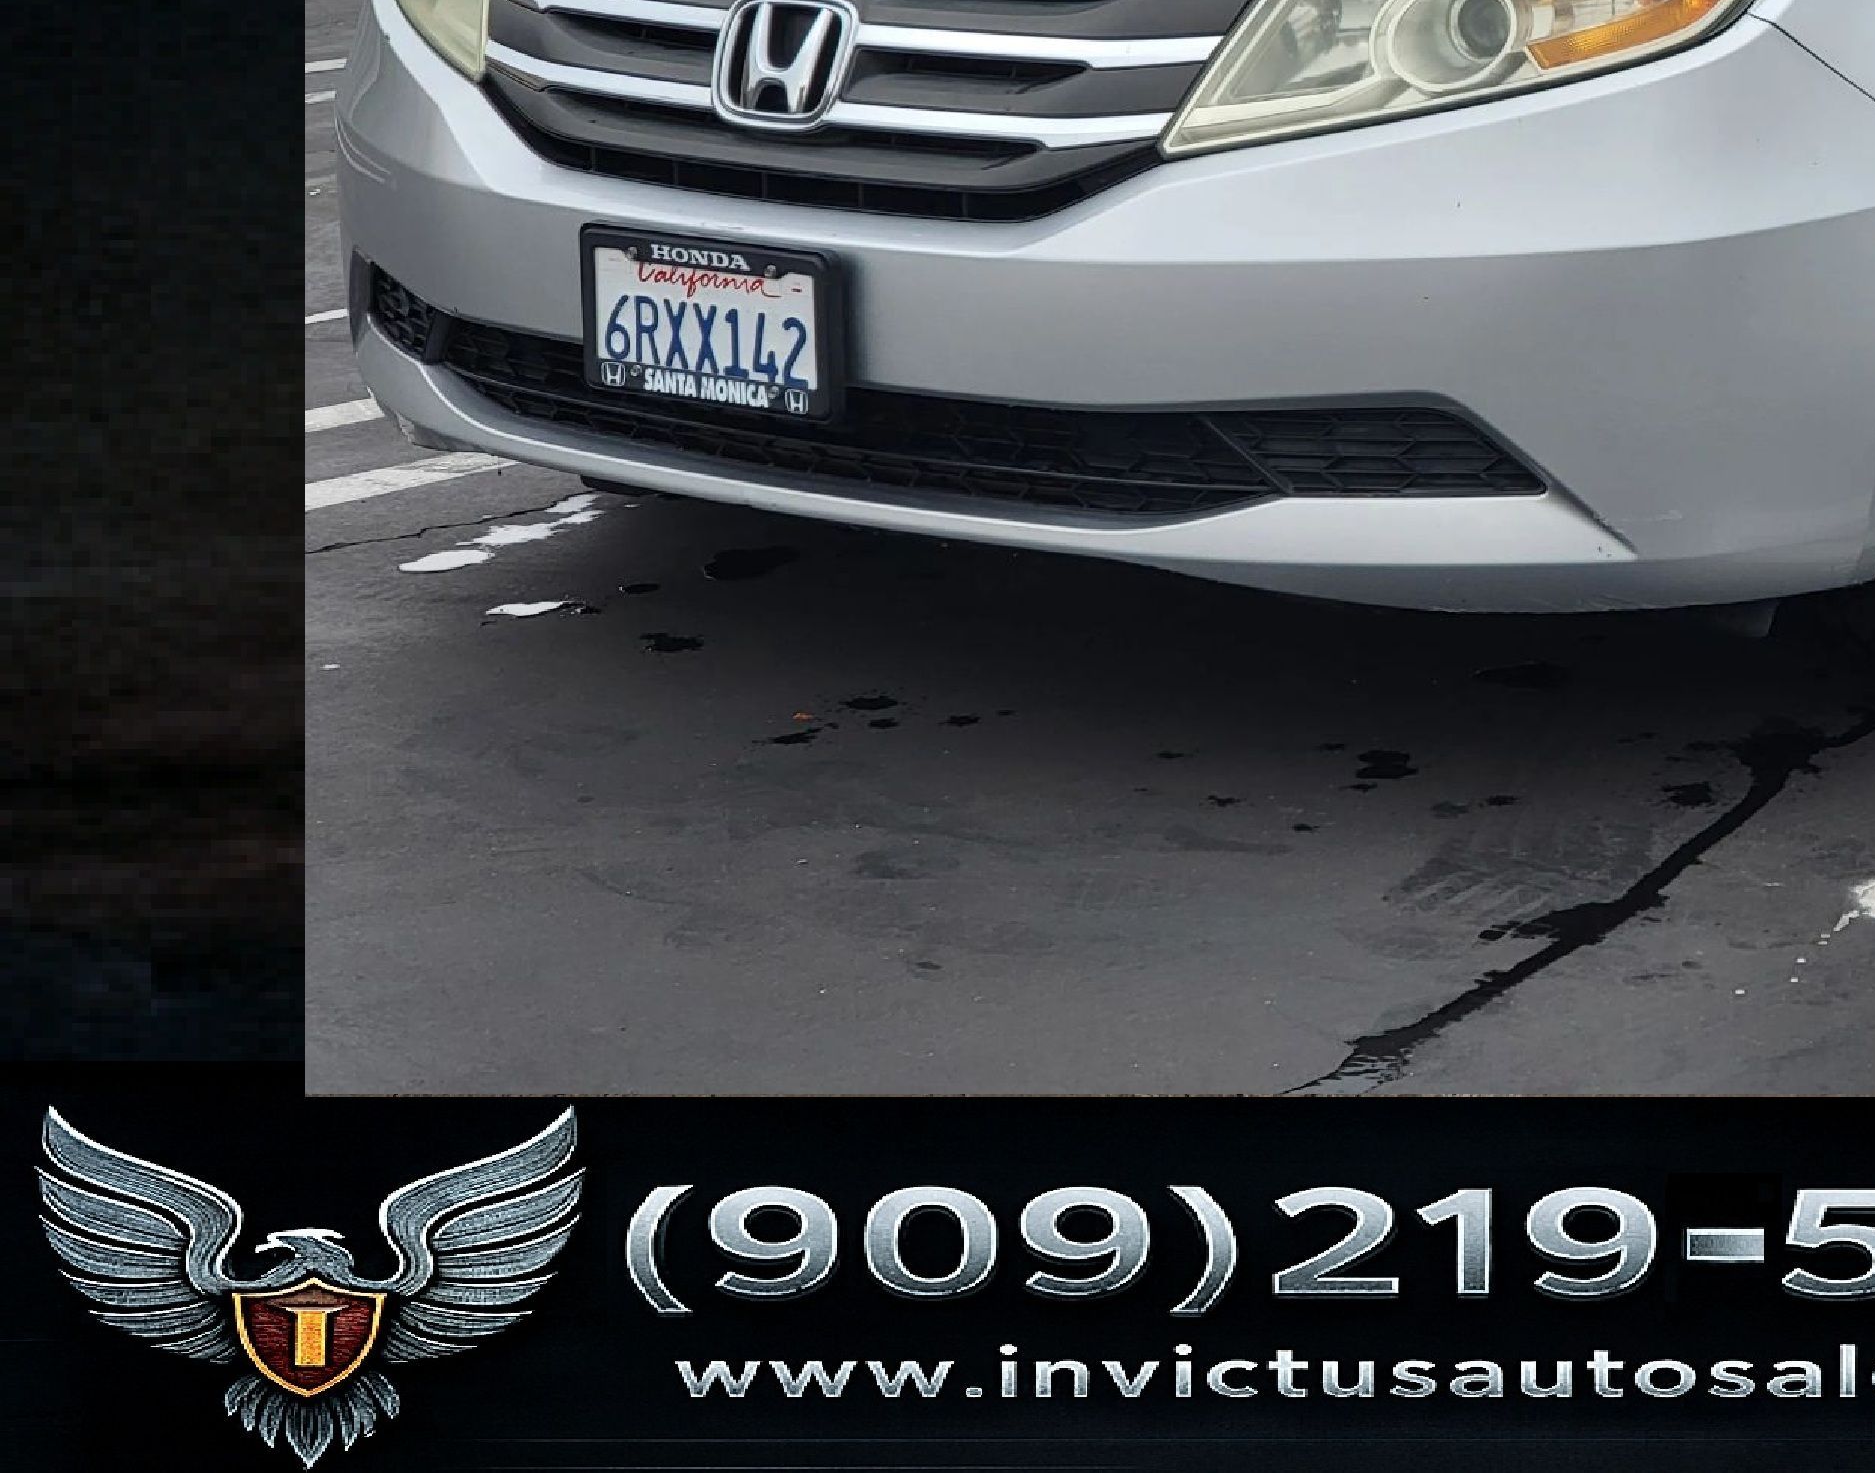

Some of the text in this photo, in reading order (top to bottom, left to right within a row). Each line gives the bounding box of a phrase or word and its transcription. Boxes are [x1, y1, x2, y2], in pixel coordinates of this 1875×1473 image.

[651, 244, 750, 271] HONDA
[606, 295, 808, 388] 6RXX142
[644, 368, 769, 409] SANTA MONICA
